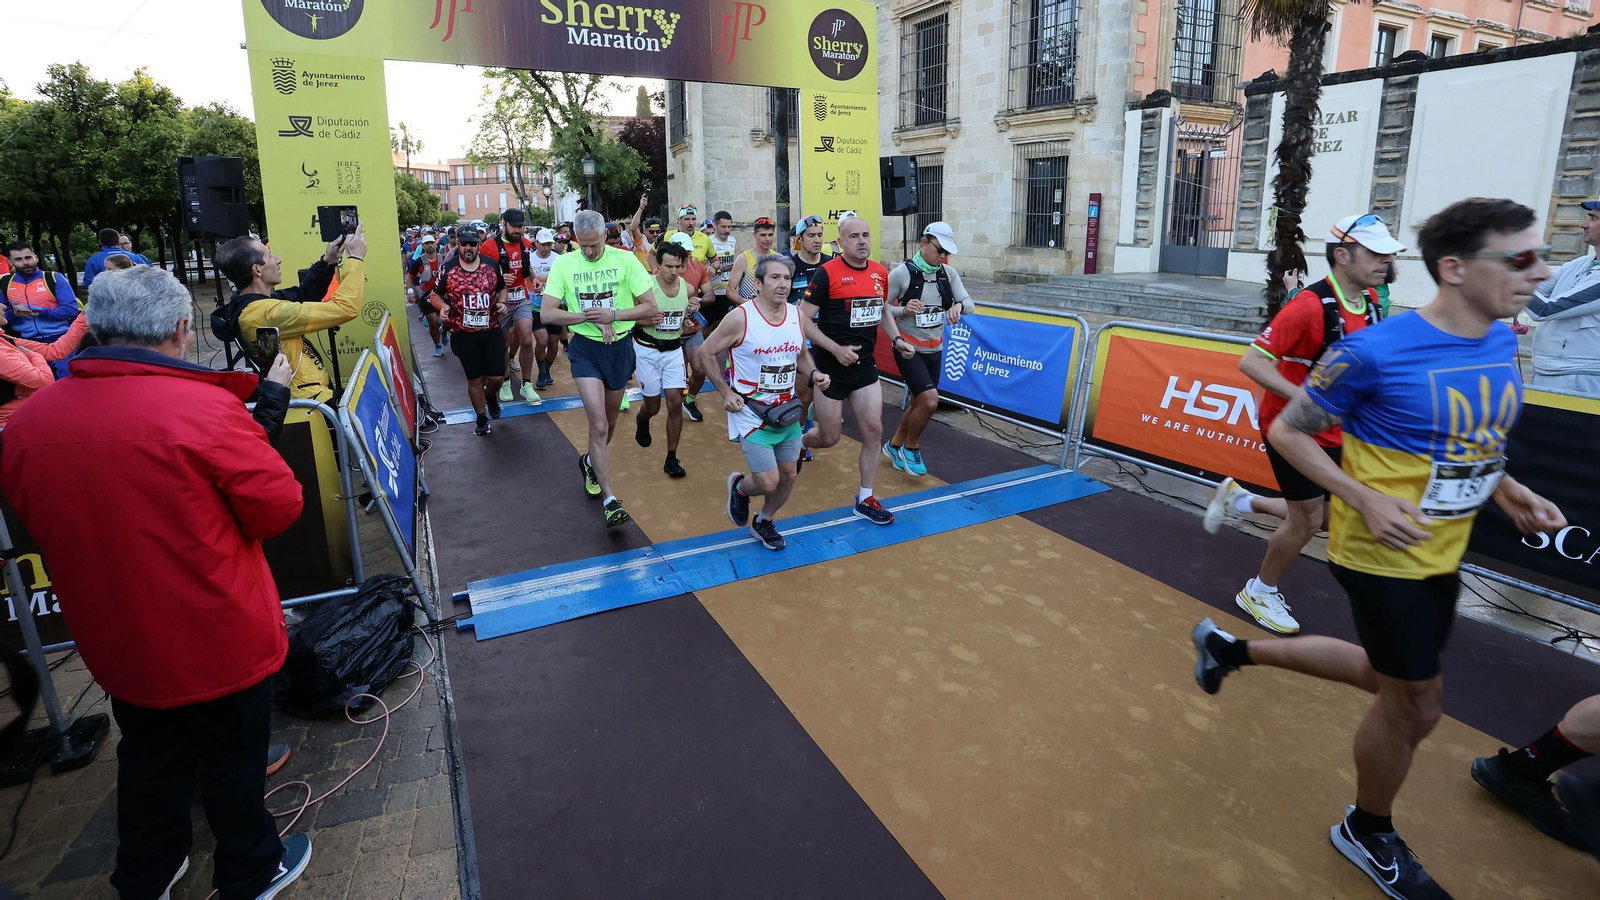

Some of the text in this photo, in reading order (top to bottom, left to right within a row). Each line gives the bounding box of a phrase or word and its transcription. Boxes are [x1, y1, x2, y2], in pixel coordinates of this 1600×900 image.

[540, 0, 681, 49] Sherry
[567, 27, 661, 52] Maratón
[813, 35, 863, 59] Sherry
[822, 50, 856, 60] Maratón
[302, 71, 365, 81] Ayuntamiento
[316, 80, 339, 88] Jerez
[830, 103, 867, 111] Ayuntamiento
[317, 116, 370, 127] Diputación
[1314, 110, 1358, 125] AZAR
[318, 129, 361, 139] de Cádiz
[836, 137, 868, 146] Diputación
[845, 146, 862, 154] Cádiz
[573, 268, 618, 285] RUN FAST
[462, 292, 490, 310] LEÃO
[591, 300, 602, 308] 69
[861, 306, 875, 317] 220
[664, 317, 678, 325] 196
[925, 313, 938, 322] 127
[753, 341, 800, 355] maratón
[974, 346, 1043, 371] Ayuntamiento
[971, 359, 1011, 379] de Jerez
[771, 373, 788, 384] 189
[1141, 413, 1267, 453] WE ARE NUTRITIO
